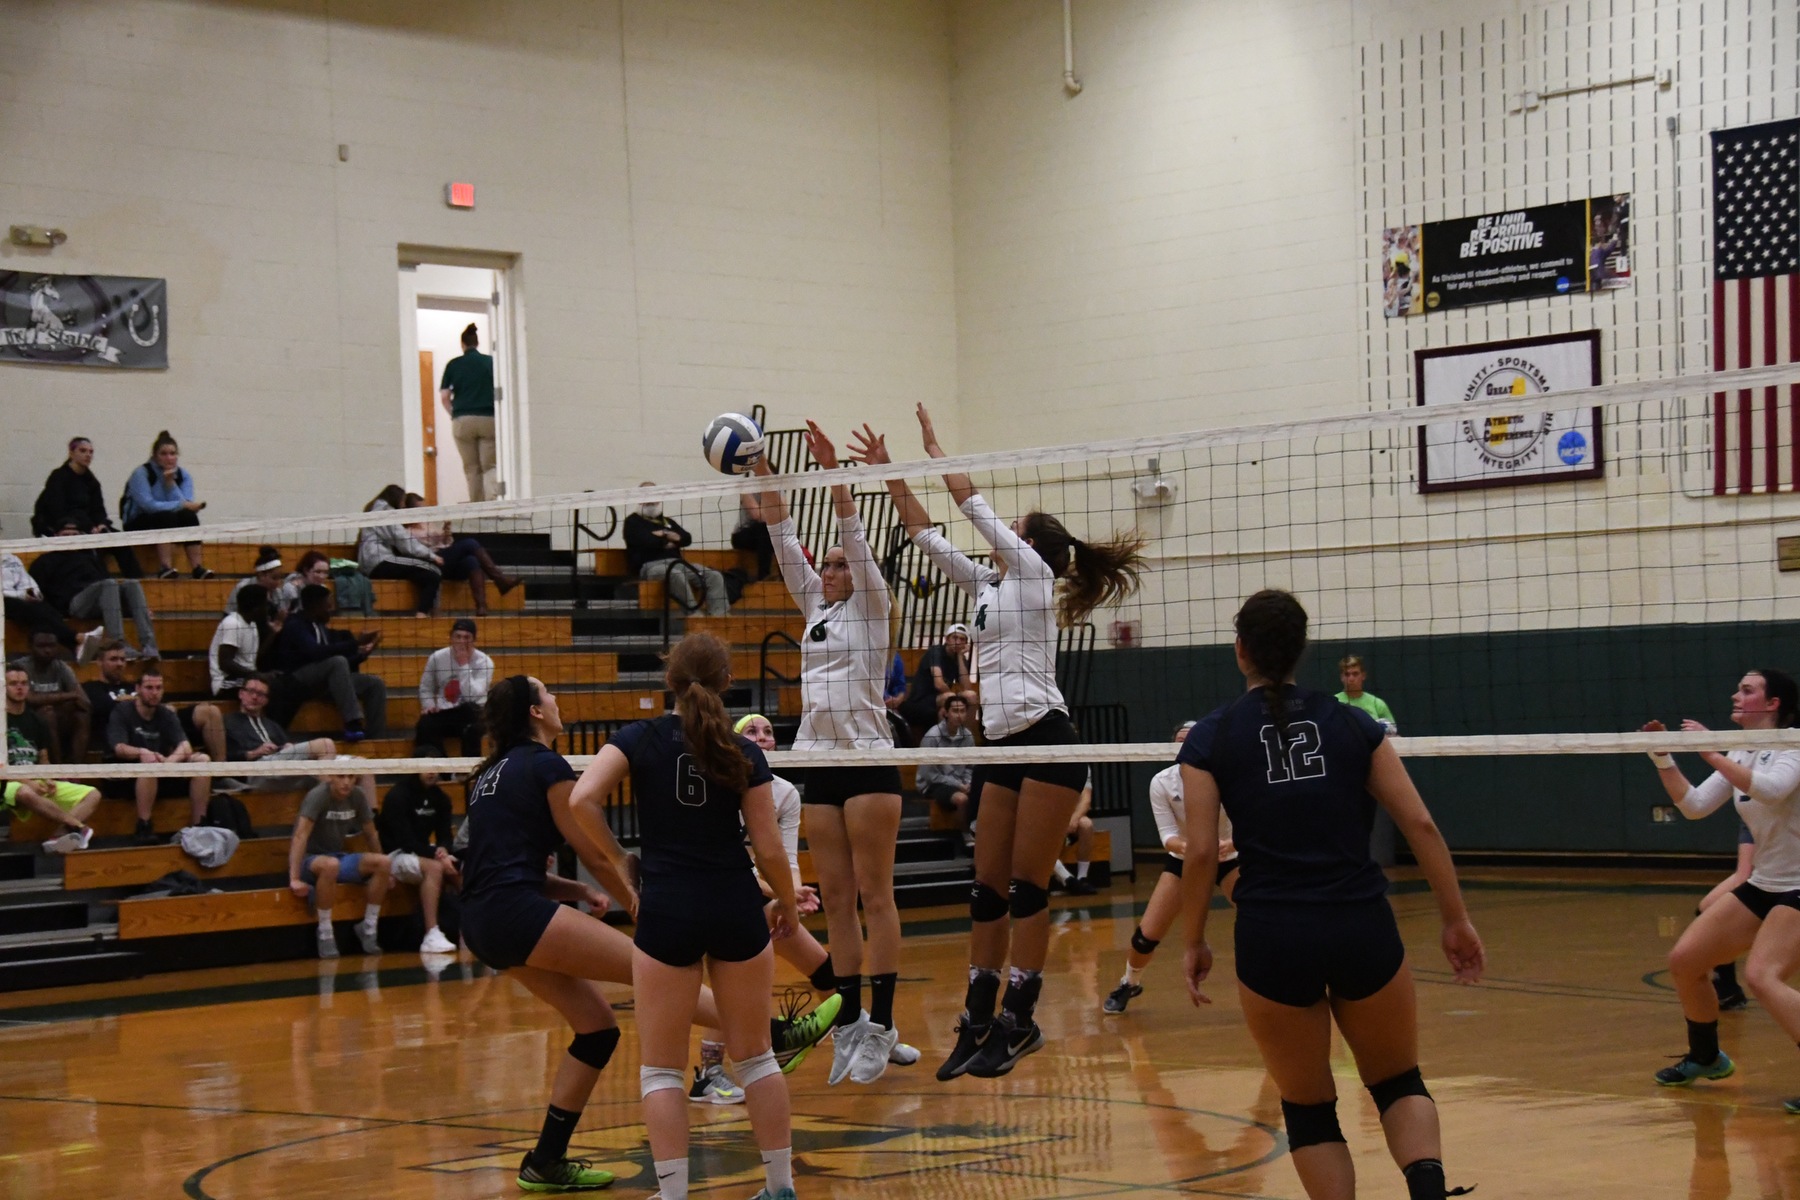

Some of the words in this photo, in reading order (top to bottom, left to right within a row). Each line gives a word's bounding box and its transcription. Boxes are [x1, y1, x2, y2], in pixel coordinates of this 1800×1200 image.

[1459, 241, 1479, 259] BE
[1481, 231, 1544, 256] POSITIVE
[1470, 228, 1488, 242] BE
[1441, 272, 1466, 282] Division
[1529, 263, 1539, 271] we
[1540, 258, 1565, 269] commit
[1446, 282, 1458, 291] fair
[1518, 272, 1530, 281] and
[1479, 447, 1538, 469] INTEGRITY
[974, 603, 989, 632] 4
[810, 619, 828, 642] 6
[1259, 720, 1326, 784] 12
[676, 752, 707, 807] 6
